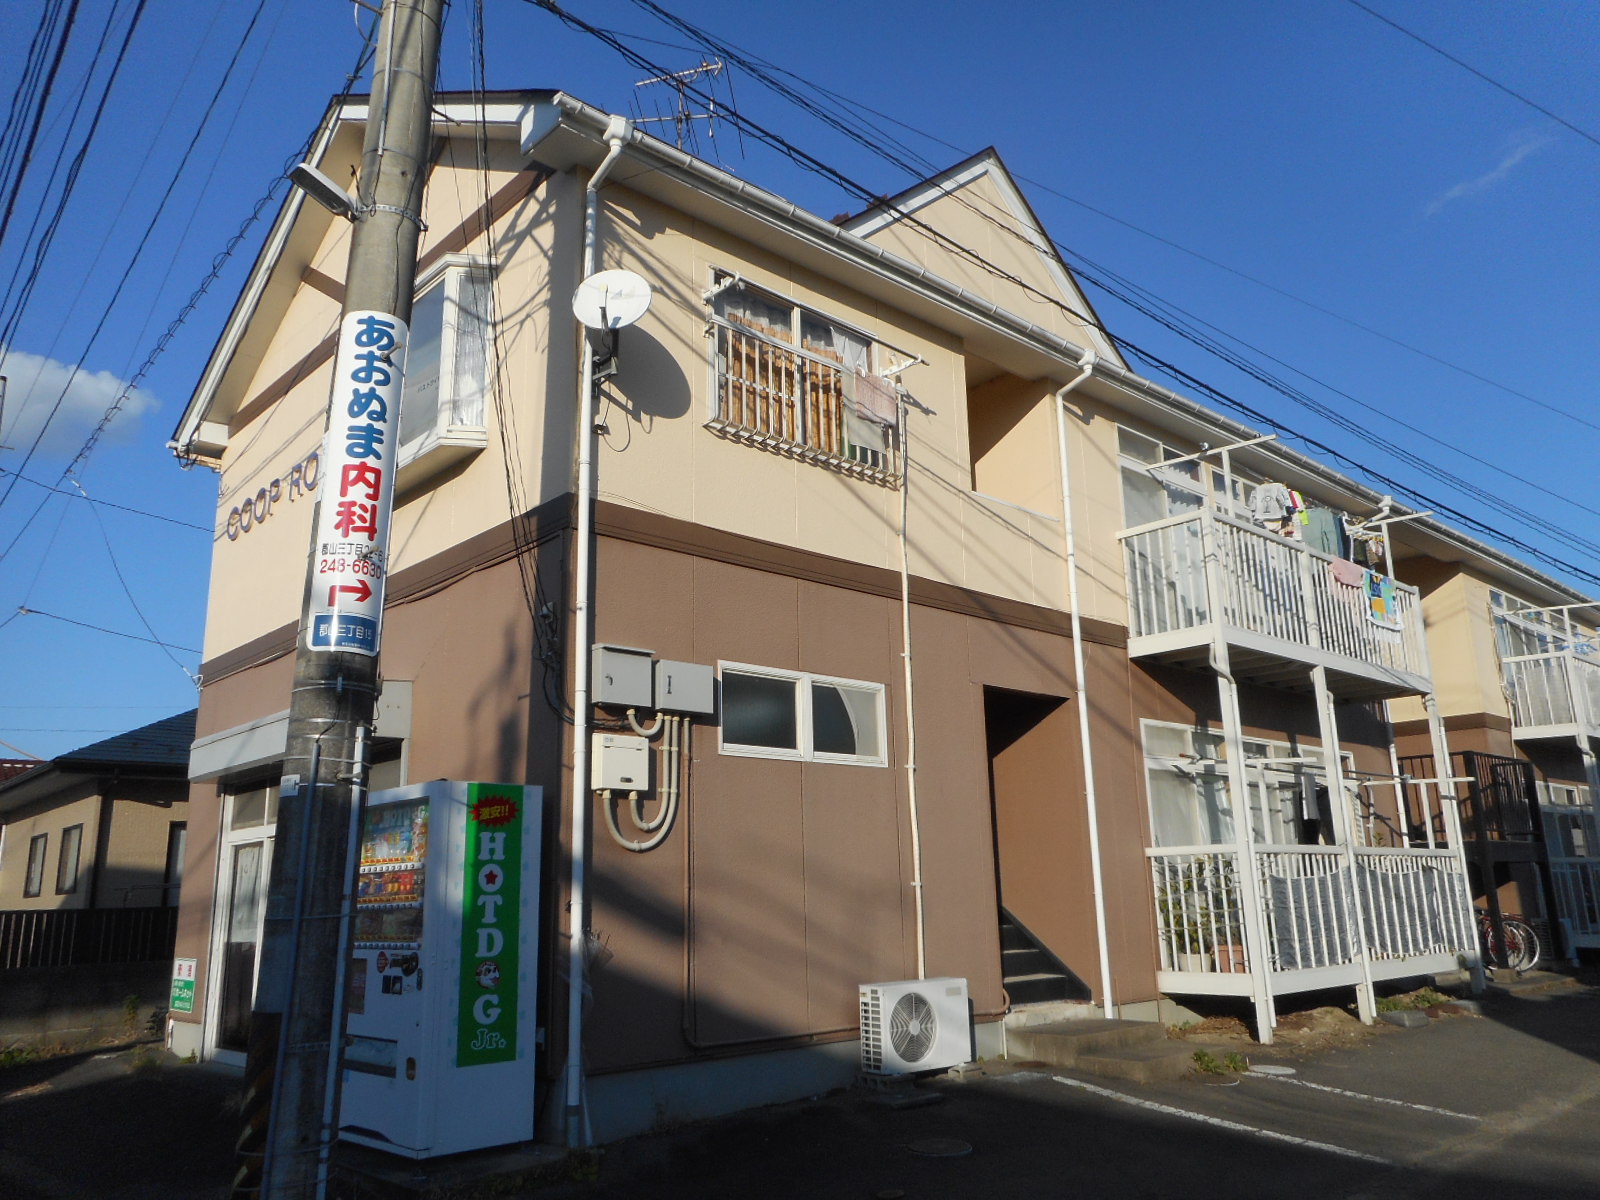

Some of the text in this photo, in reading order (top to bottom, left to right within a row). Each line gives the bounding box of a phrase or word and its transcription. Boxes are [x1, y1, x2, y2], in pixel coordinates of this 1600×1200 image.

[334, 315, 395, 541] あおぬま内科
[227, 478, 281, 541] COOP
[320, 558, 381, 580] 248-6630
